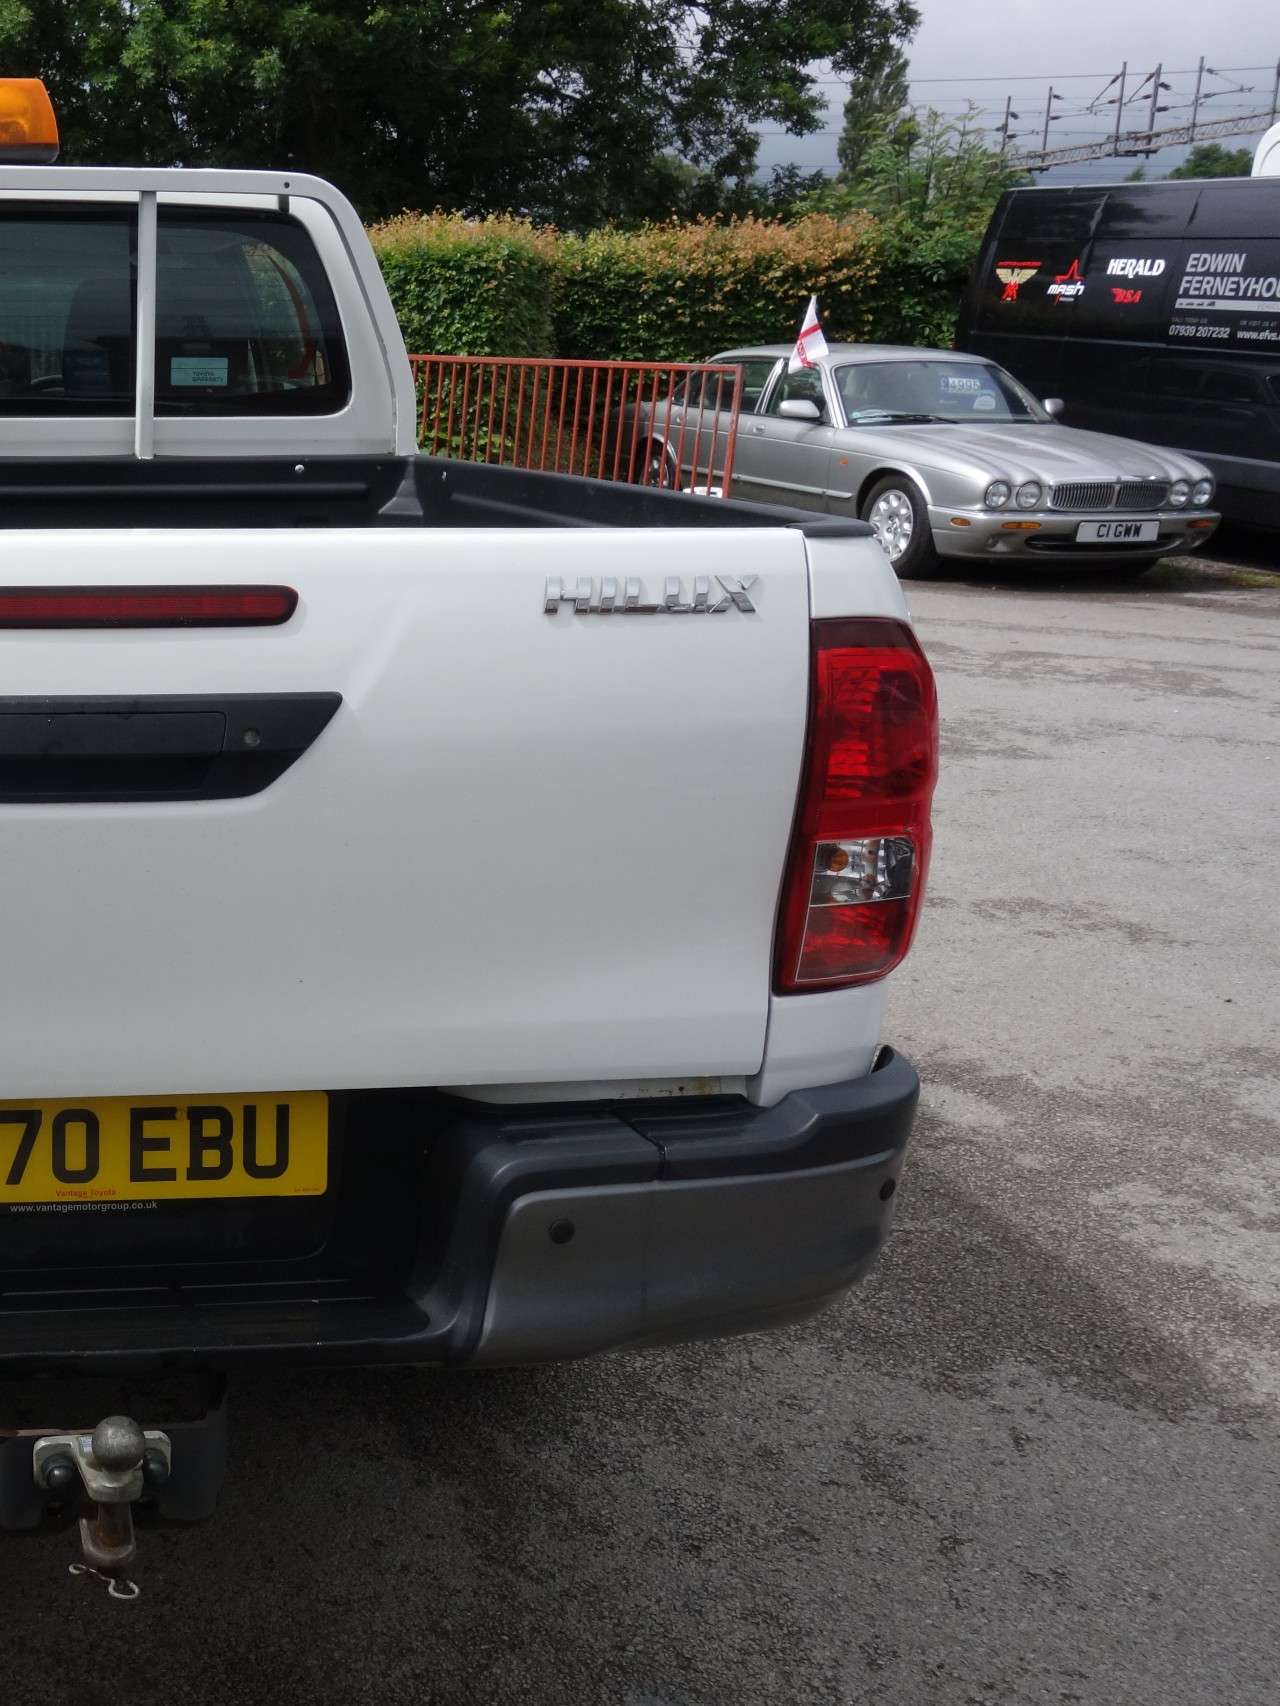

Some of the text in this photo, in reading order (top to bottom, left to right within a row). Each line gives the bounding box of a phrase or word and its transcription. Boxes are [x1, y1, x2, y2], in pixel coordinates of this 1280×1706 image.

[1107, 258, 1165, 278] HERALD
[1185, 253, 1247, 272] EDWIN
[1168, 325, 1231, 338] 07939 207232
[1237, 329, 1280, 340] www.efvs.
[544, 575, 759, 614] HILUX
[129, 1103, 290, 1183] EBU
[55, 1188, 116, 1199] Vantage Toyota
[9, 1200, 159, 1213] www.vantagemotorgroup.co.uk
